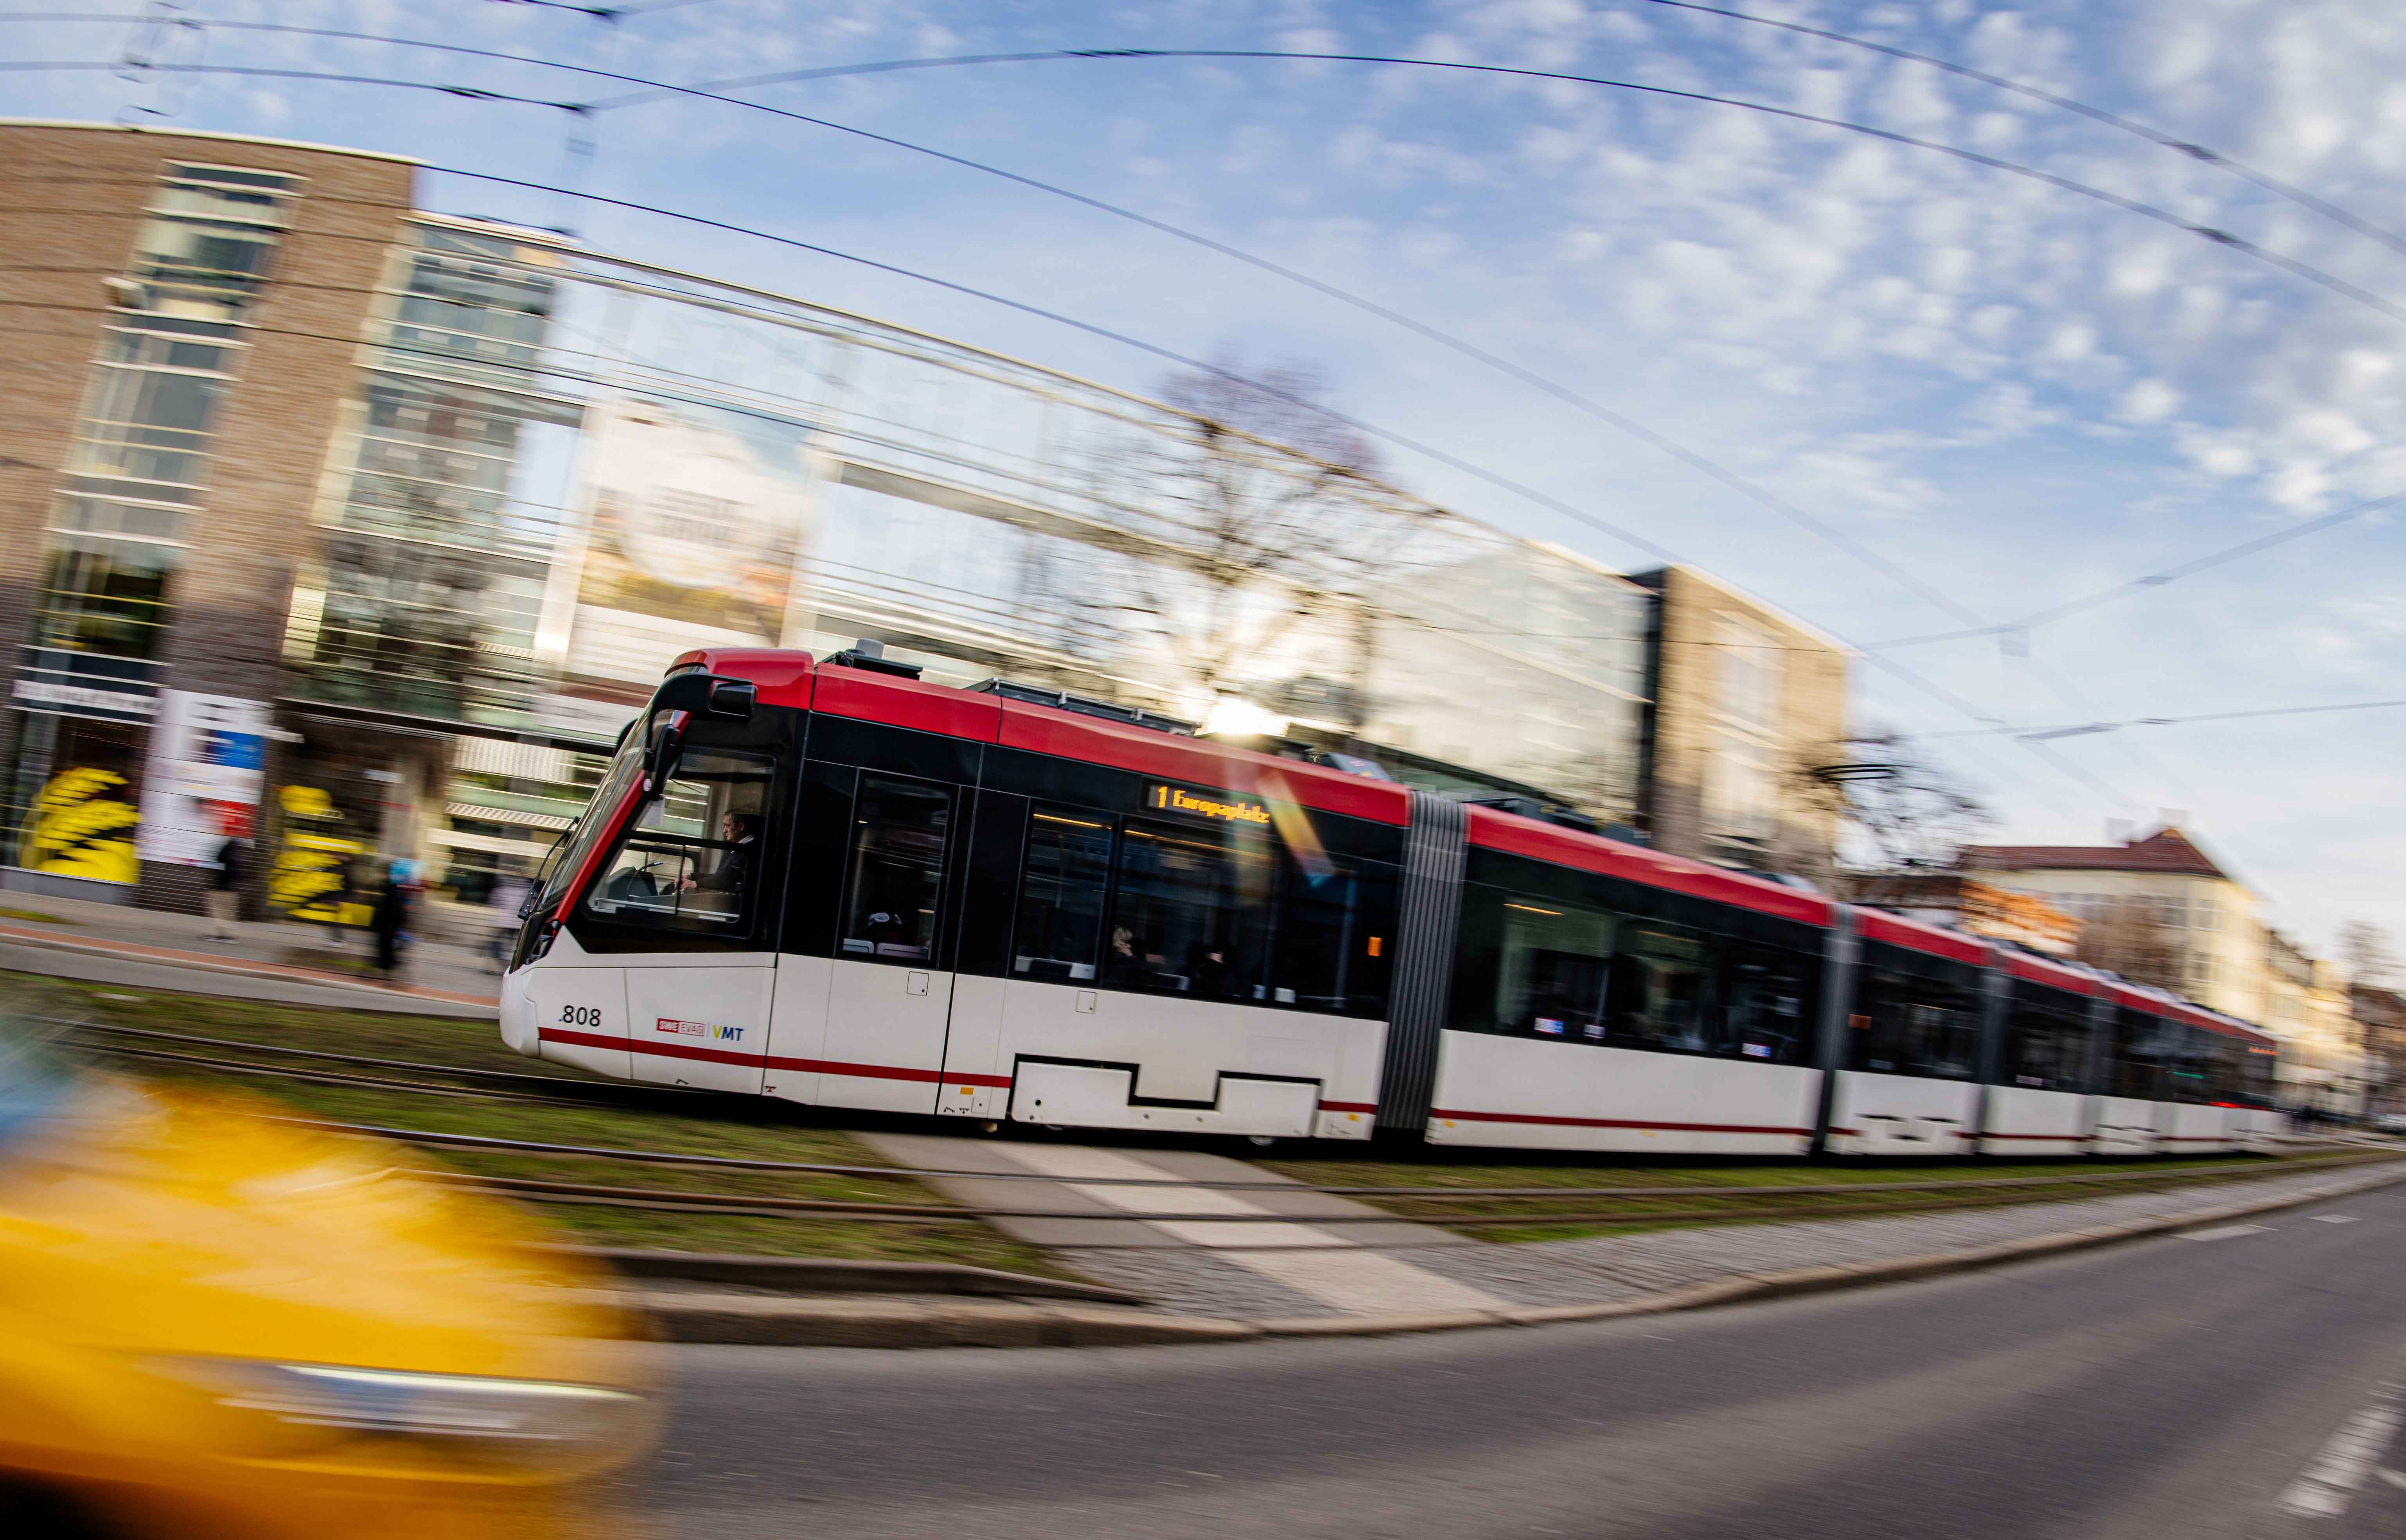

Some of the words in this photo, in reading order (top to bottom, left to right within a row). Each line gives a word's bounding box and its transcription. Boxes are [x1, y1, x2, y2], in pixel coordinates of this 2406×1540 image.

[1158, 786, 1168, 807] 1
[1173, 790, 1270, 823] Europaplatz
[563, 1005, 601, 1027] 808
[681, 1023, 704, 1034] EVAG
[712, 1025, 744, 1041] VMT
